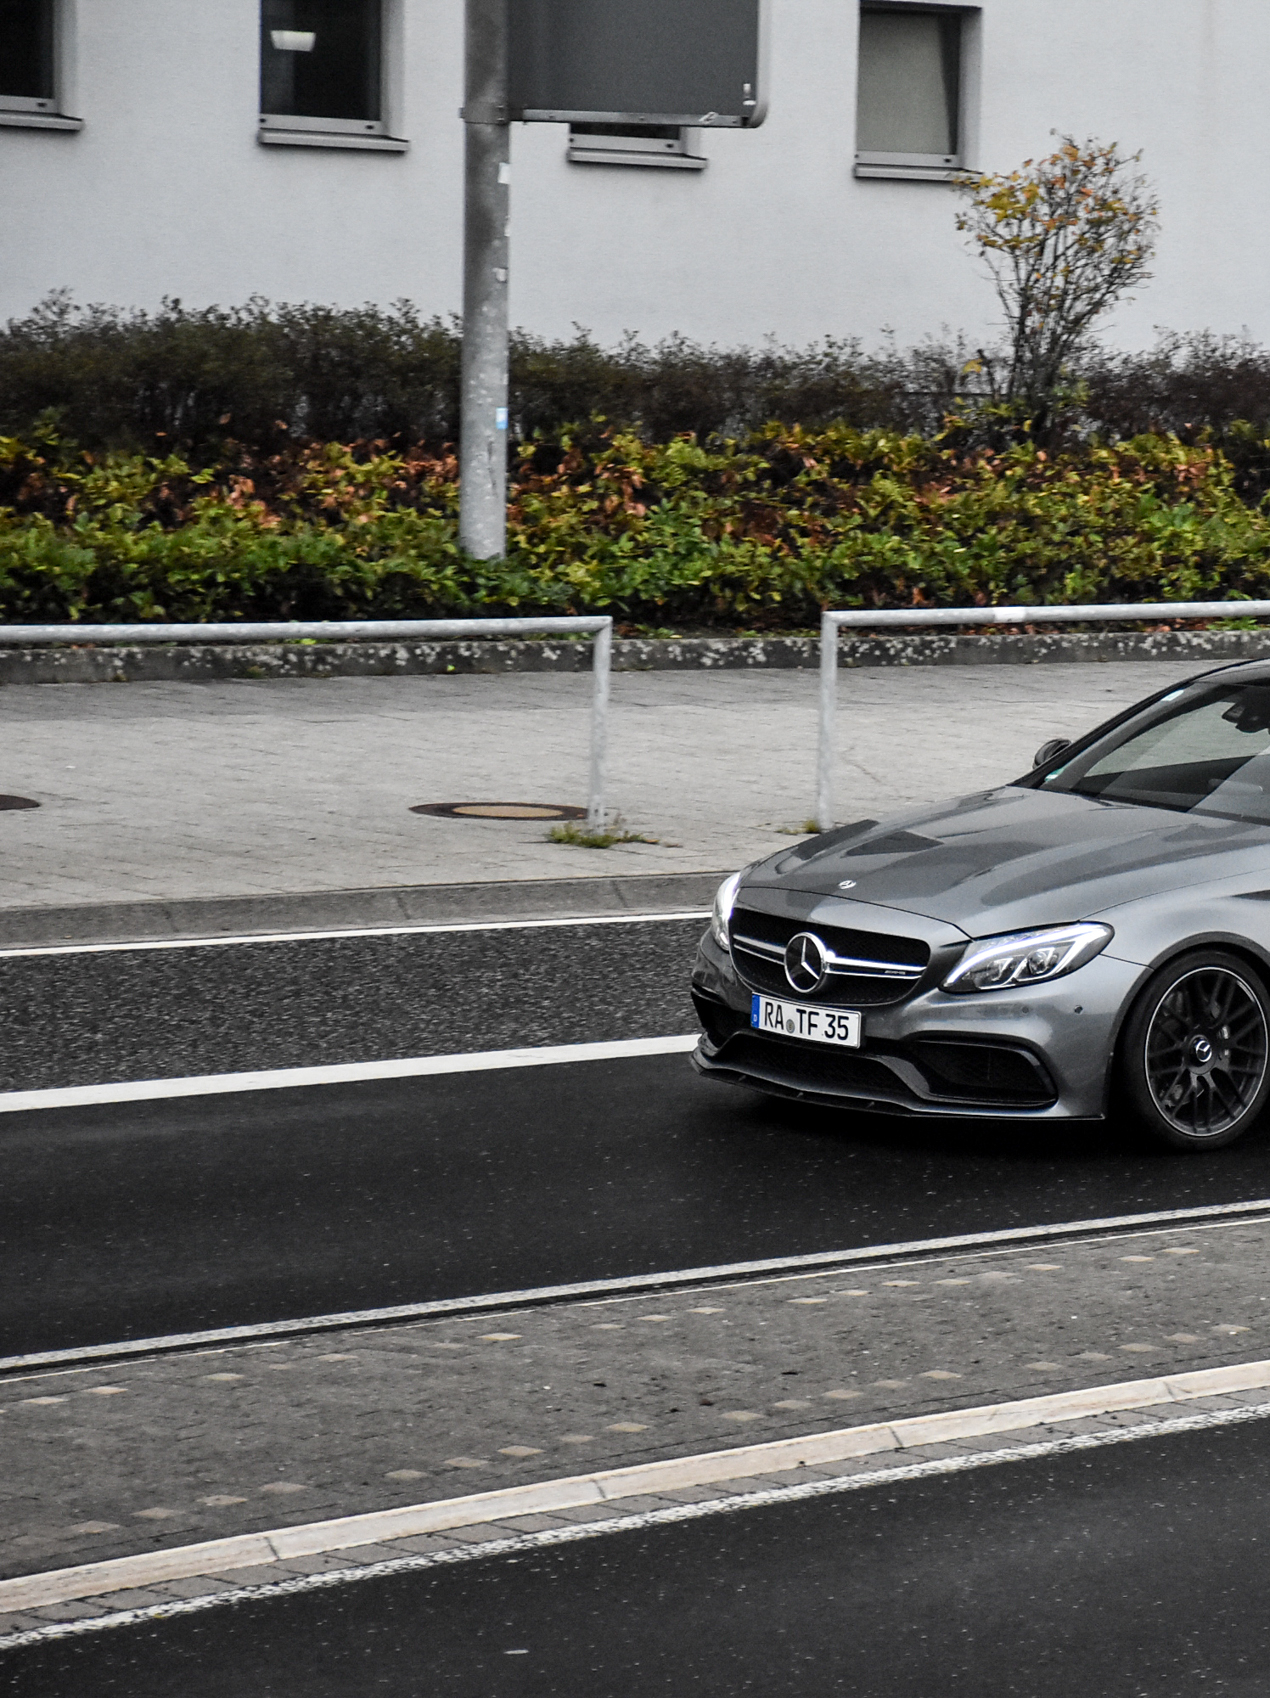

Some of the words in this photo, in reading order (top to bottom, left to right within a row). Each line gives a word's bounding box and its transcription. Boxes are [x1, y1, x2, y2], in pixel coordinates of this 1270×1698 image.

[764, 1001, 784, 1030] RA
[796, 1008, 820, 1036] TF
[824, 1013, 850, 1041] 35
